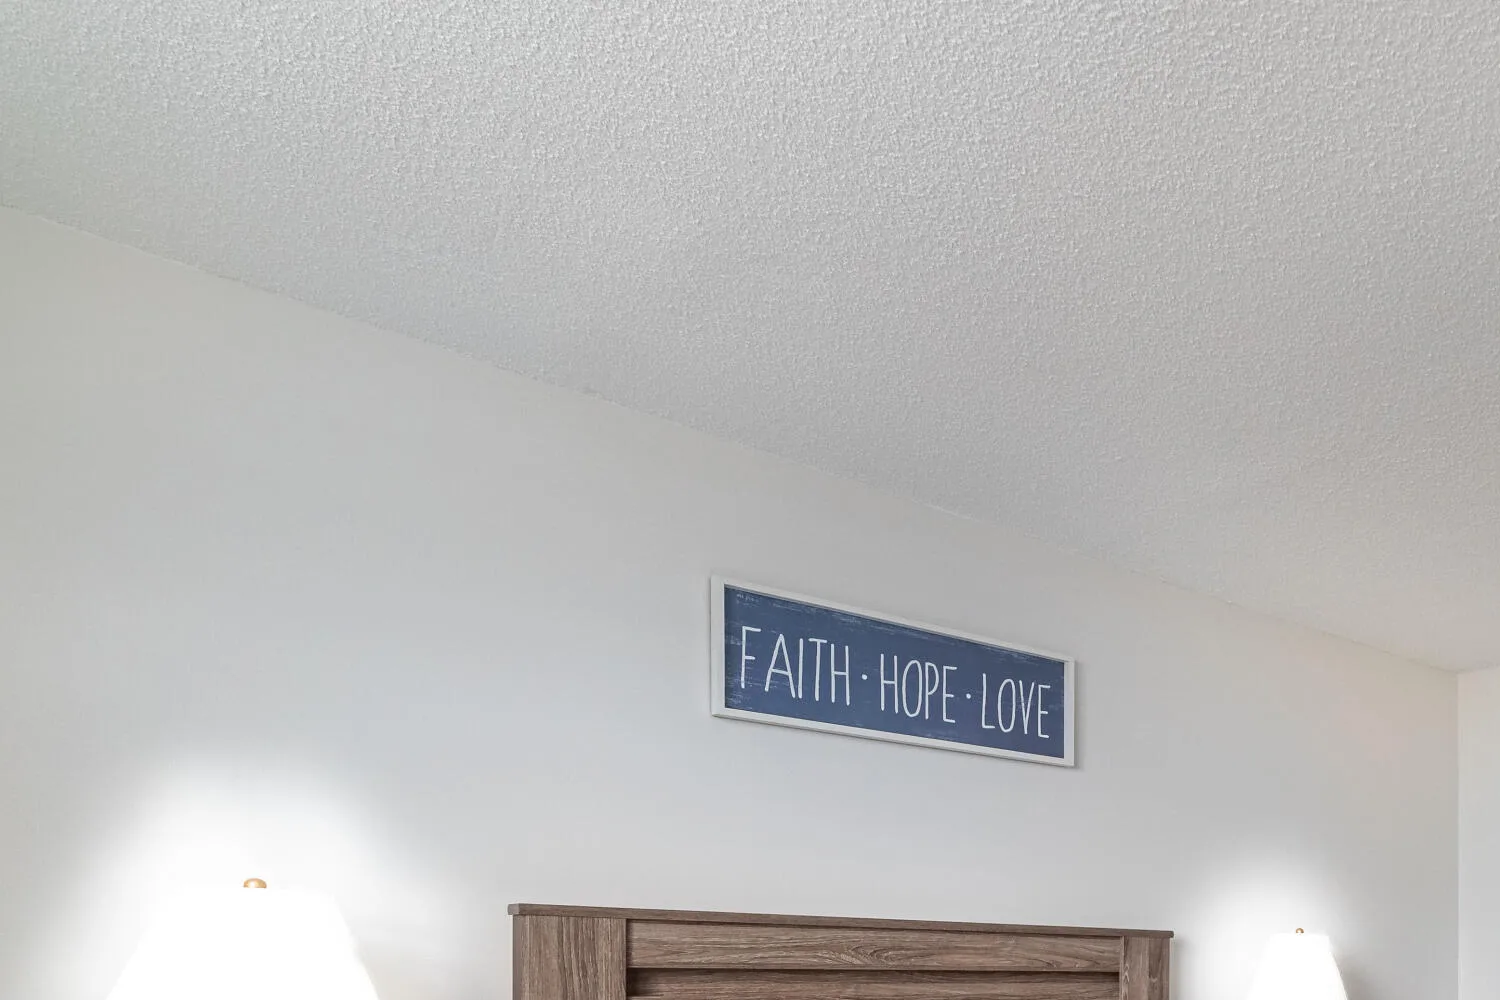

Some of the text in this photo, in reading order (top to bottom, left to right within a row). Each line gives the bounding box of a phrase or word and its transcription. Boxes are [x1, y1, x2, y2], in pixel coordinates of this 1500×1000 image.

[740, 626, 1051, 739] FAITH HOPE LOVE
